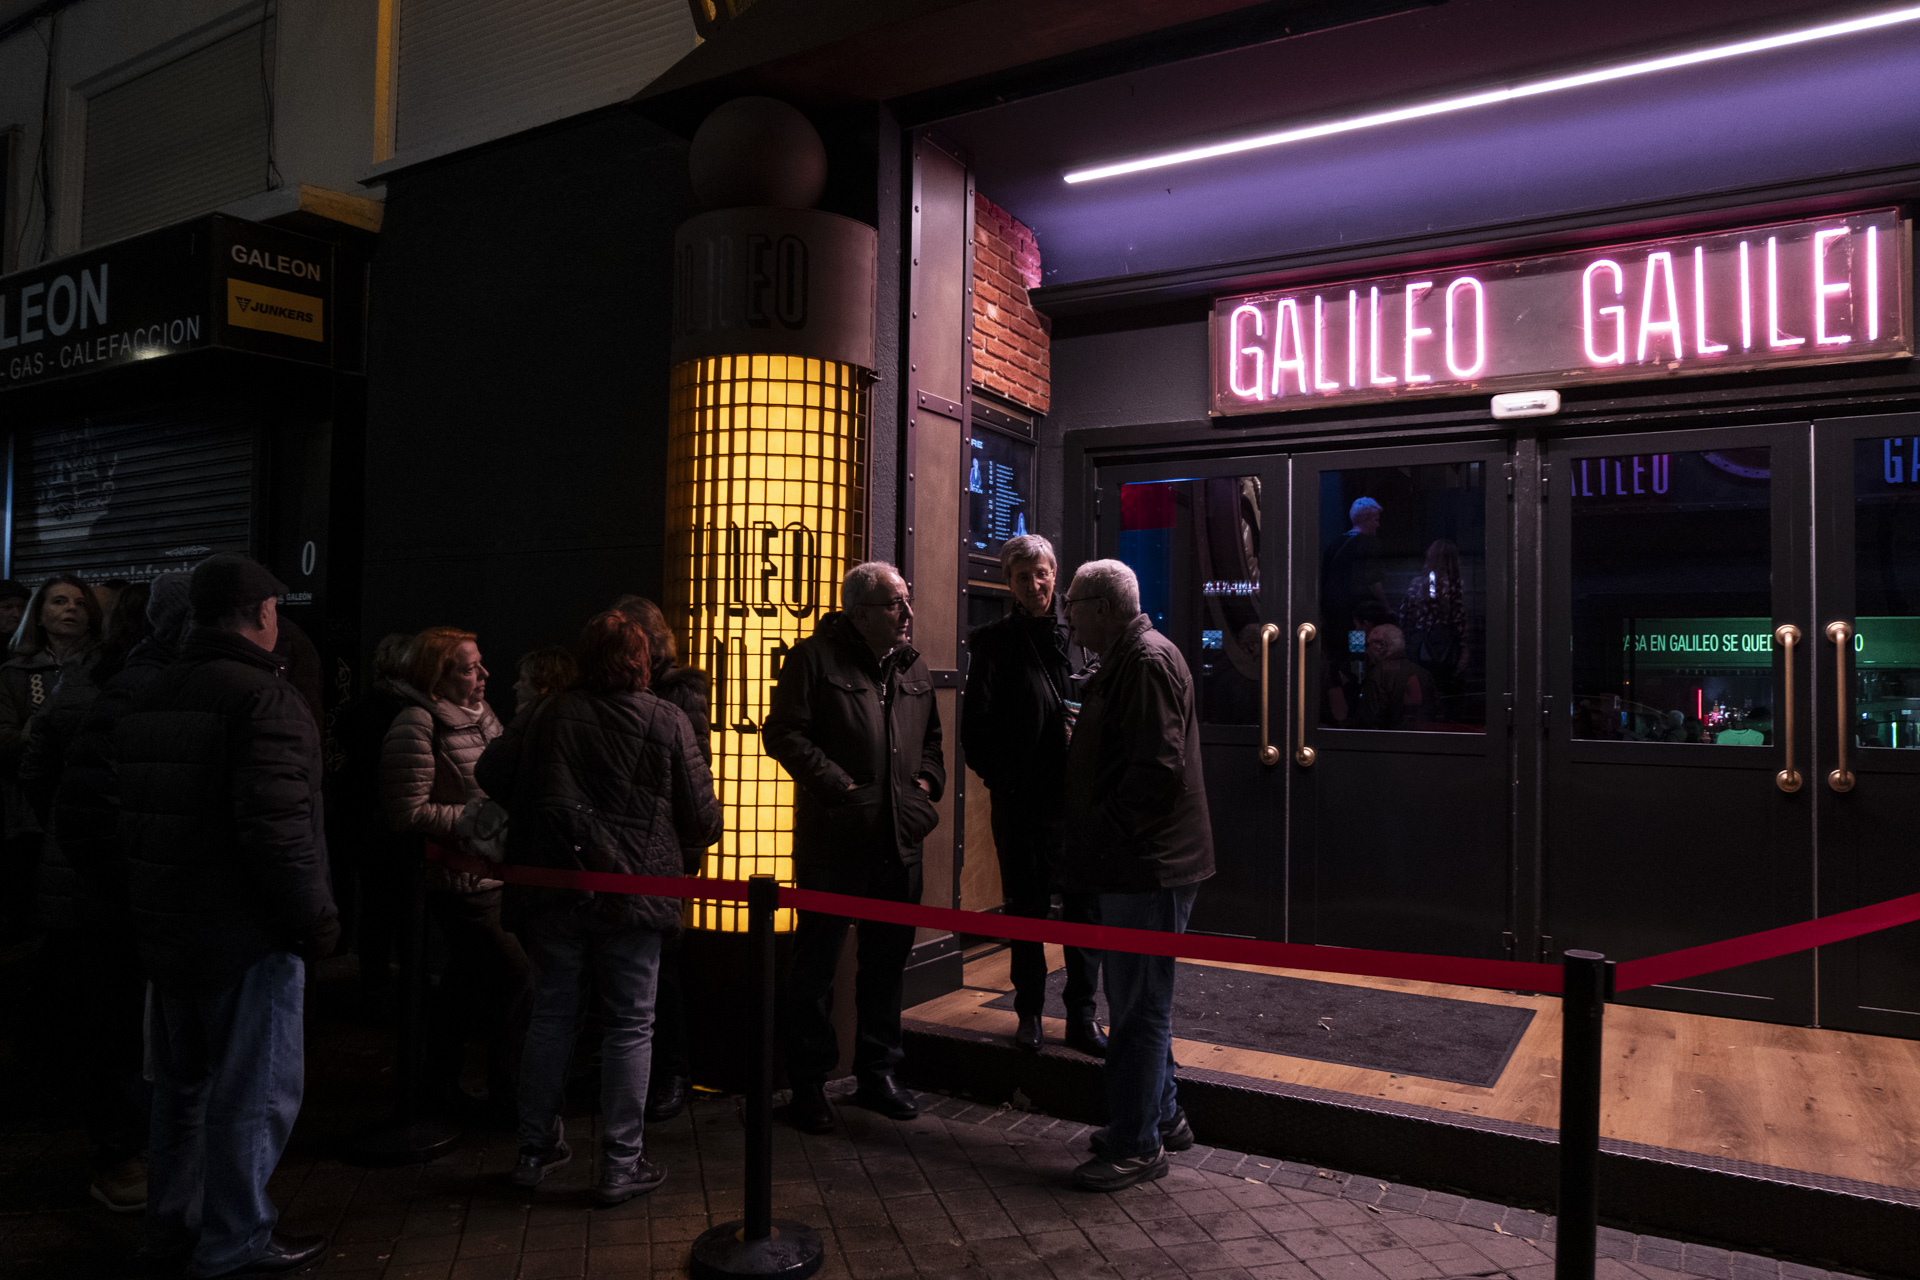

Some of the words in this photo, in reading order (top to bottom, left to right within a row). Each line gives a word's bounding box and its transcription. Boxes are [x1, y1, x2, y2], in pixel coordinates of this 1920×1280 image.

[231, 244, 321, 282] GALEON
[251, 302, 313, 322] JUNKERS
[1229, 276, 1485, 401] GALILEO
[1582, 225, 1879, 366] GALILEI
[9, 352, 43, 379] GAS
[60, 314, 200, 368] CALEFACCION
[1623, 634, 1648, 652] ASA
[1650, 634, 1666, 651] EN
[1669, 634, 1719, 652] GALILEO
[1722, 634, 1738, 651] SE
